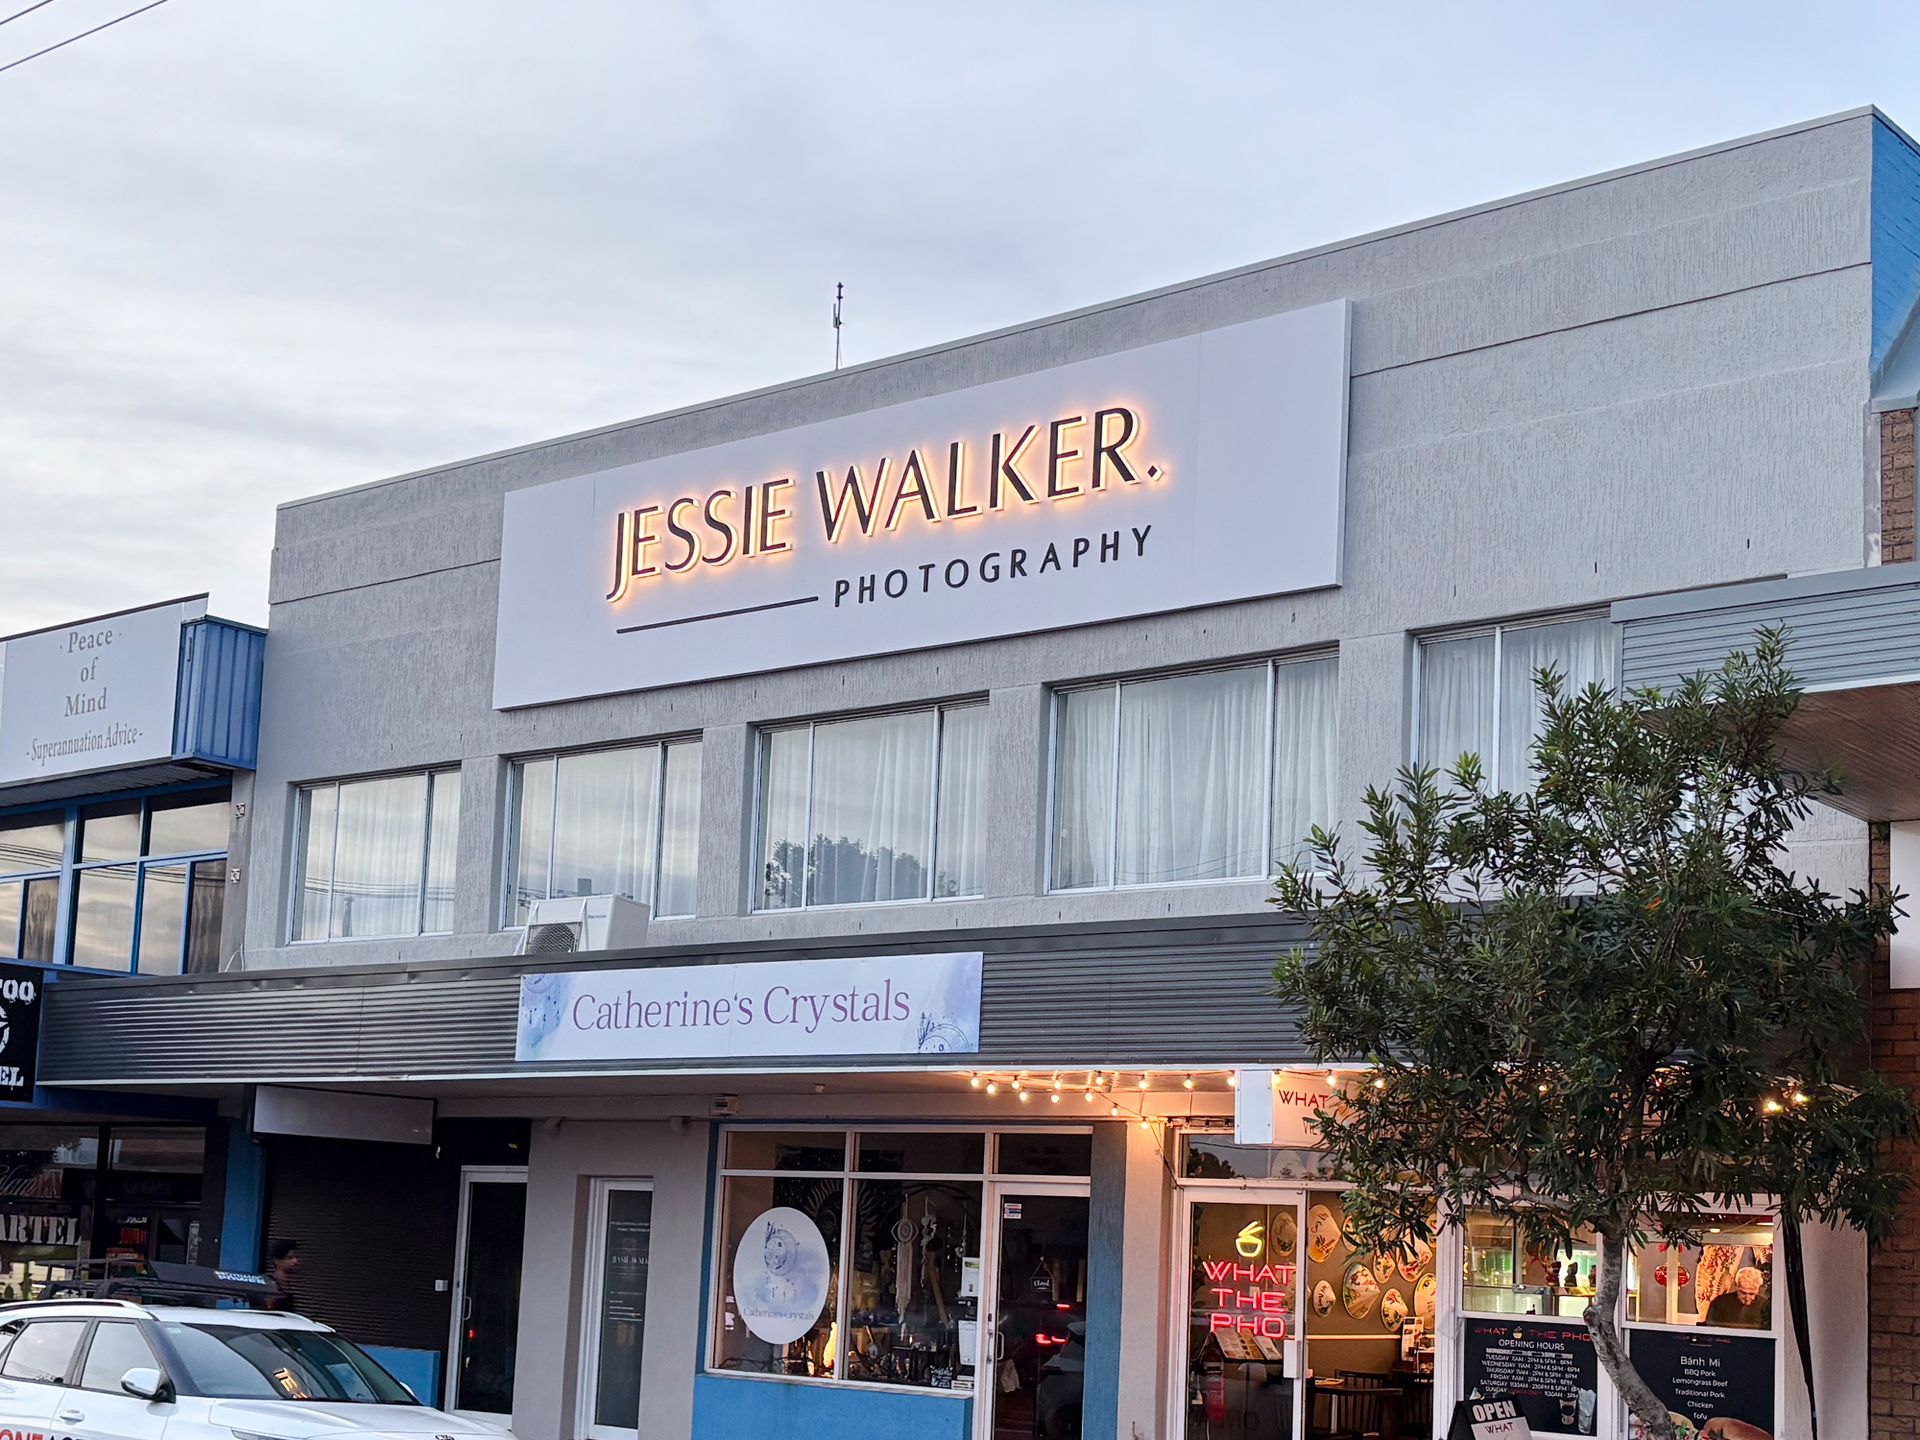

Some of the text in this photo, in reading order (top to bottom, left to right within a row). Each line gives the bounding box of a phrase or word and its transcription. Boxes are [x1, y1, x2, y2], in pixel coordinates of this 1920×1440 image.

[606, 406, 1164, 602] JESSIE WALKER.
[834, 524, 1152, 608] PHOTOGRAPHY
[68, 629, 113, 653] Peace
[80, 656, 99, 682] of
[64, 687, 107, 717] Mind
[31, 722, 138, 766] Superannuation Advice
[0, 979, 35, 1004] OO
[573, 978, 911, 1034] Catherine's Crystals
[1279, 1089, 1328, 1109] WHAT
[1202, 1261, 1296, 1286] WHAT
[1211, 1287, 1287, 1312] THE
[1210, 1313, 1286, 1339] PHO
[1561, 1331, 1592, 1342] PHO
[1498, 1339, 1565, 1350] OPENING HOURS
[1680, 1355, 1705, 1366] Bánh
[1672, 1377, 1711, 1387] Lemongrass
[1684, 1368, 1716, 1377] BBQ Pork
[1675, 1388, 1709, 1397] Traditional
[1472, 1400, 1517, 1422] OPEN
[1687, 1400, 1714, 1409] Chicken
[1693, 1412, 1708, 1420] Tofu
[1484, 1421, 1514, 1434] WHAT
